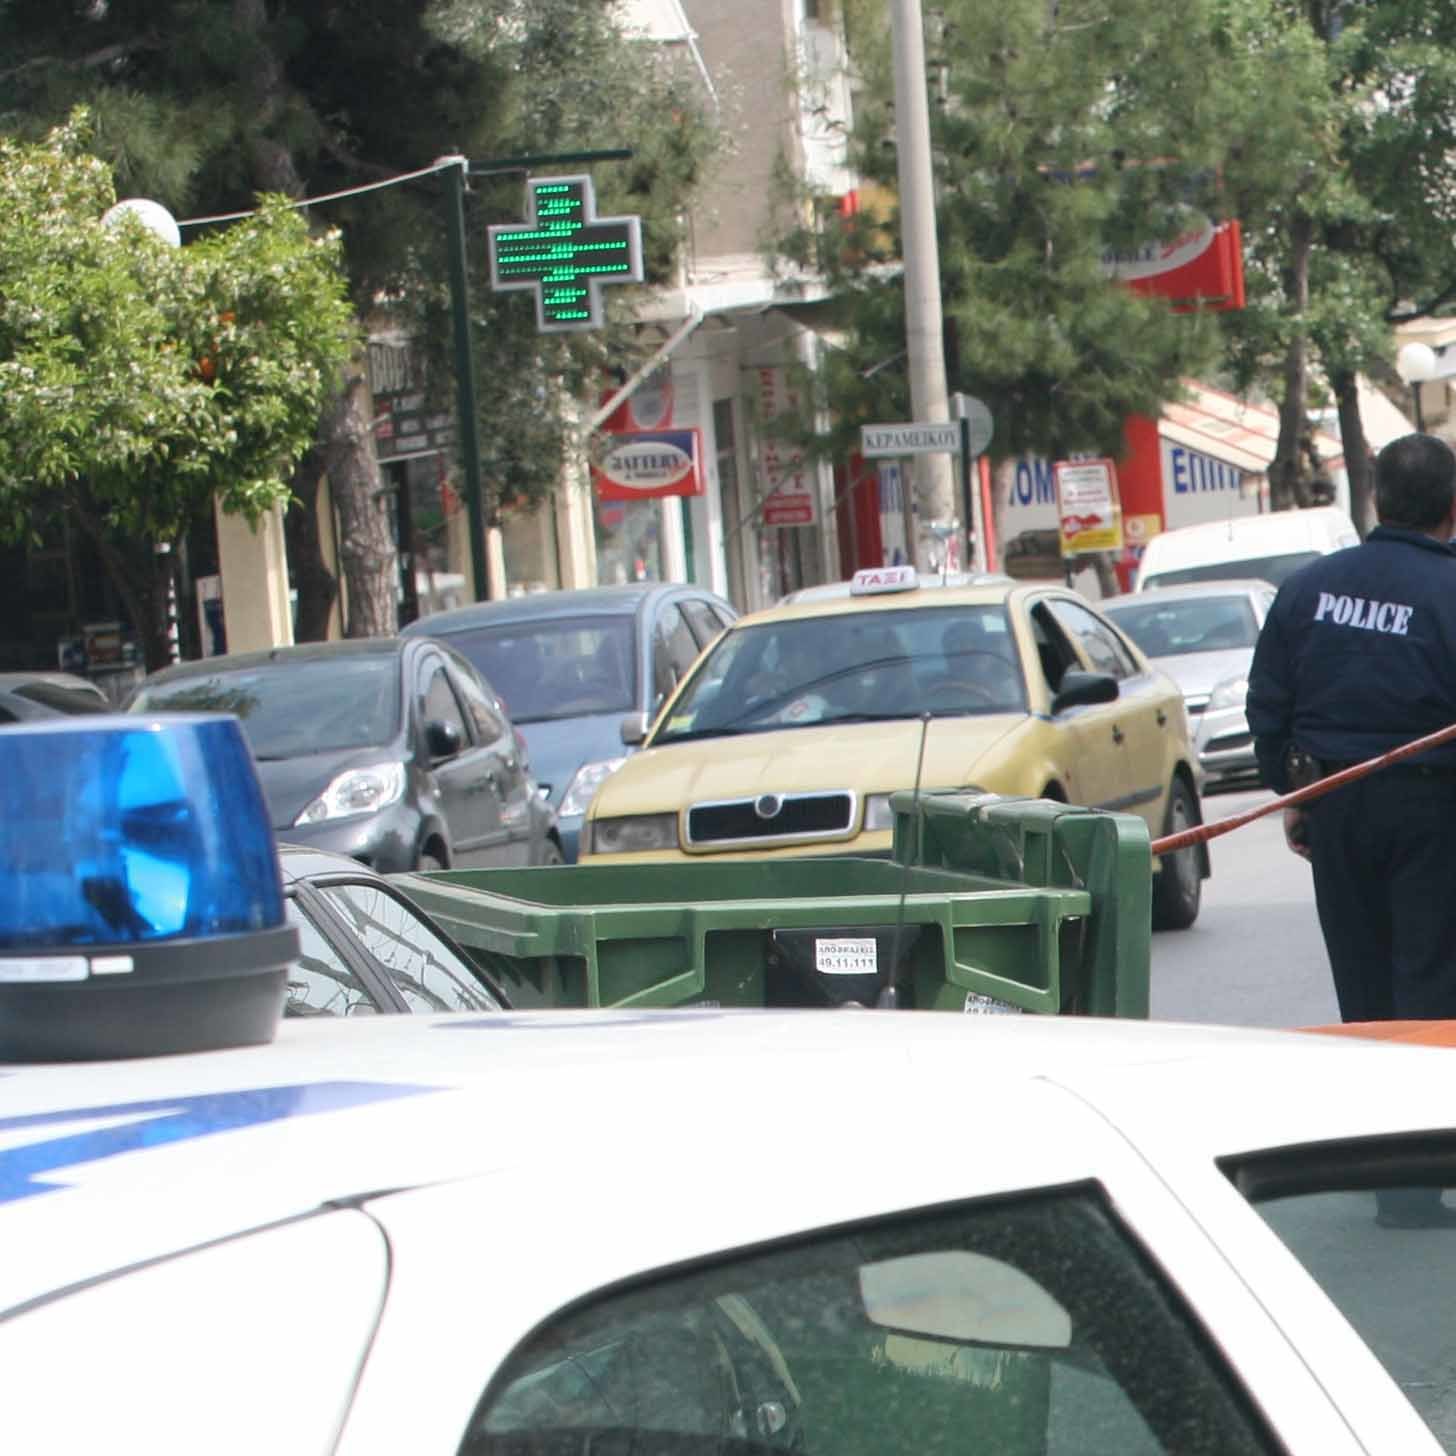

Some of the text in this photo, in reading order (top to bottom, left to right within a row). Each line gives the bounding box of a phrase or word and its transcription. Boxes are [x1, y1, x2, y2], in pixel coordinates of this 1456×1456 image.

[864, 428, 960, 450] ΚΕΡΑΜΕΙΚΟΥ
[858, 571, 908, 588] ΤΑΞΙ
[1313, 591, 1414, 636] POLICE
